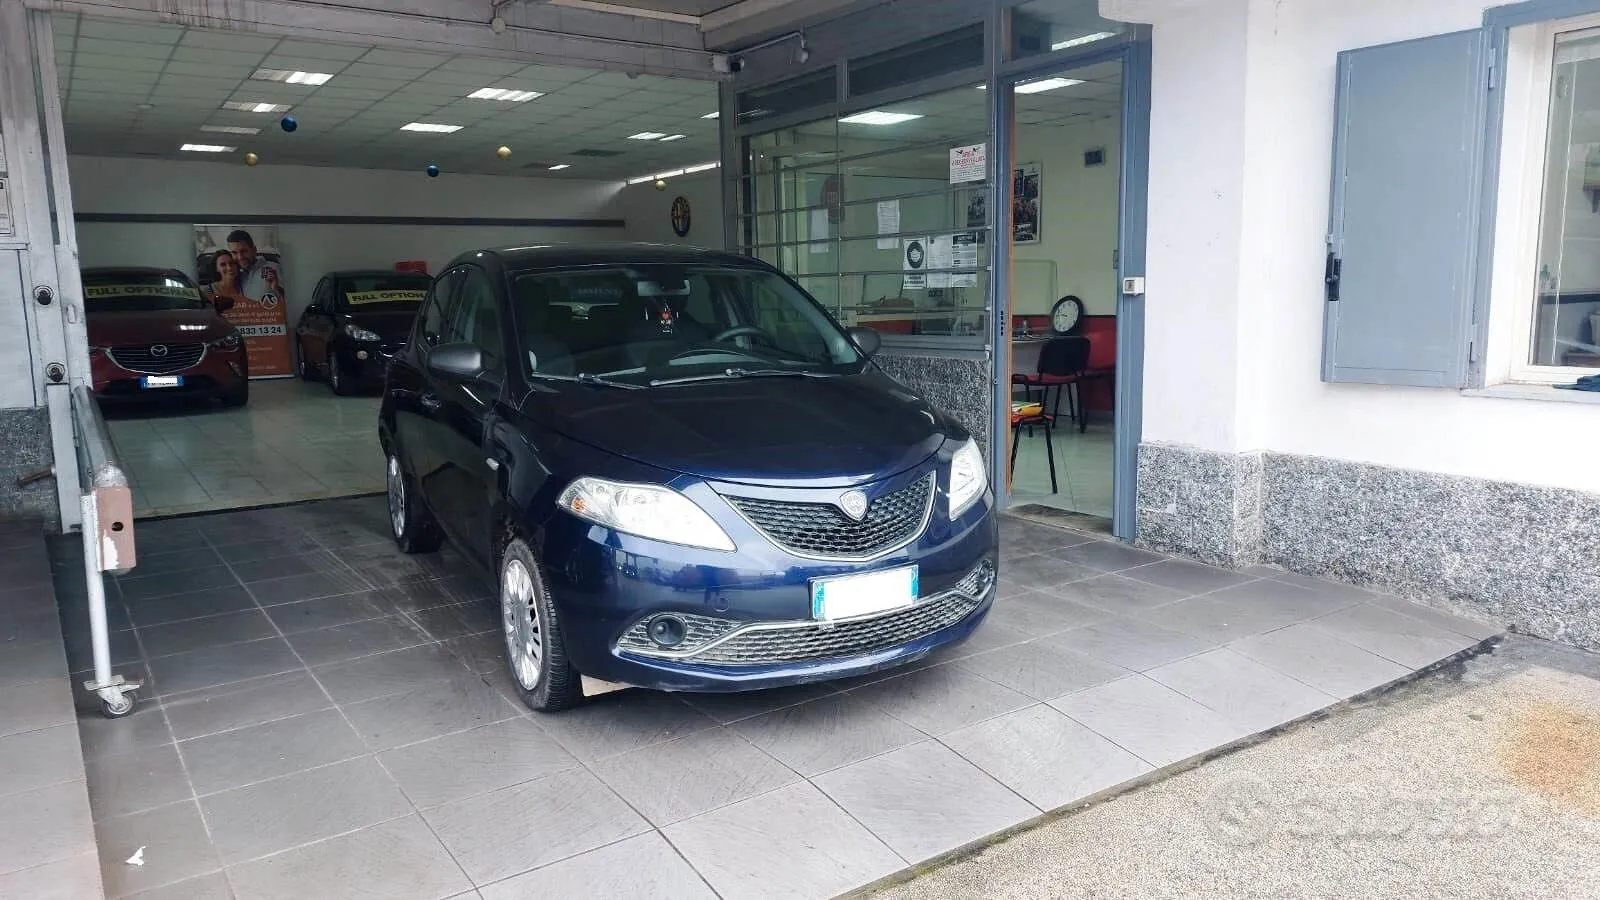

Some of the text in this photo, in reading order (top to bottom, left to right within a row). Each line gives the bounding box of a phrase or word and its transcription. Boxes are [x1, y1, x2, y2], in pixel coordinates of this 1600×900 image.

[87, 286, 199, 298] FULL OPTIONAL
[240, 326, 282, 335] 833 13 24
